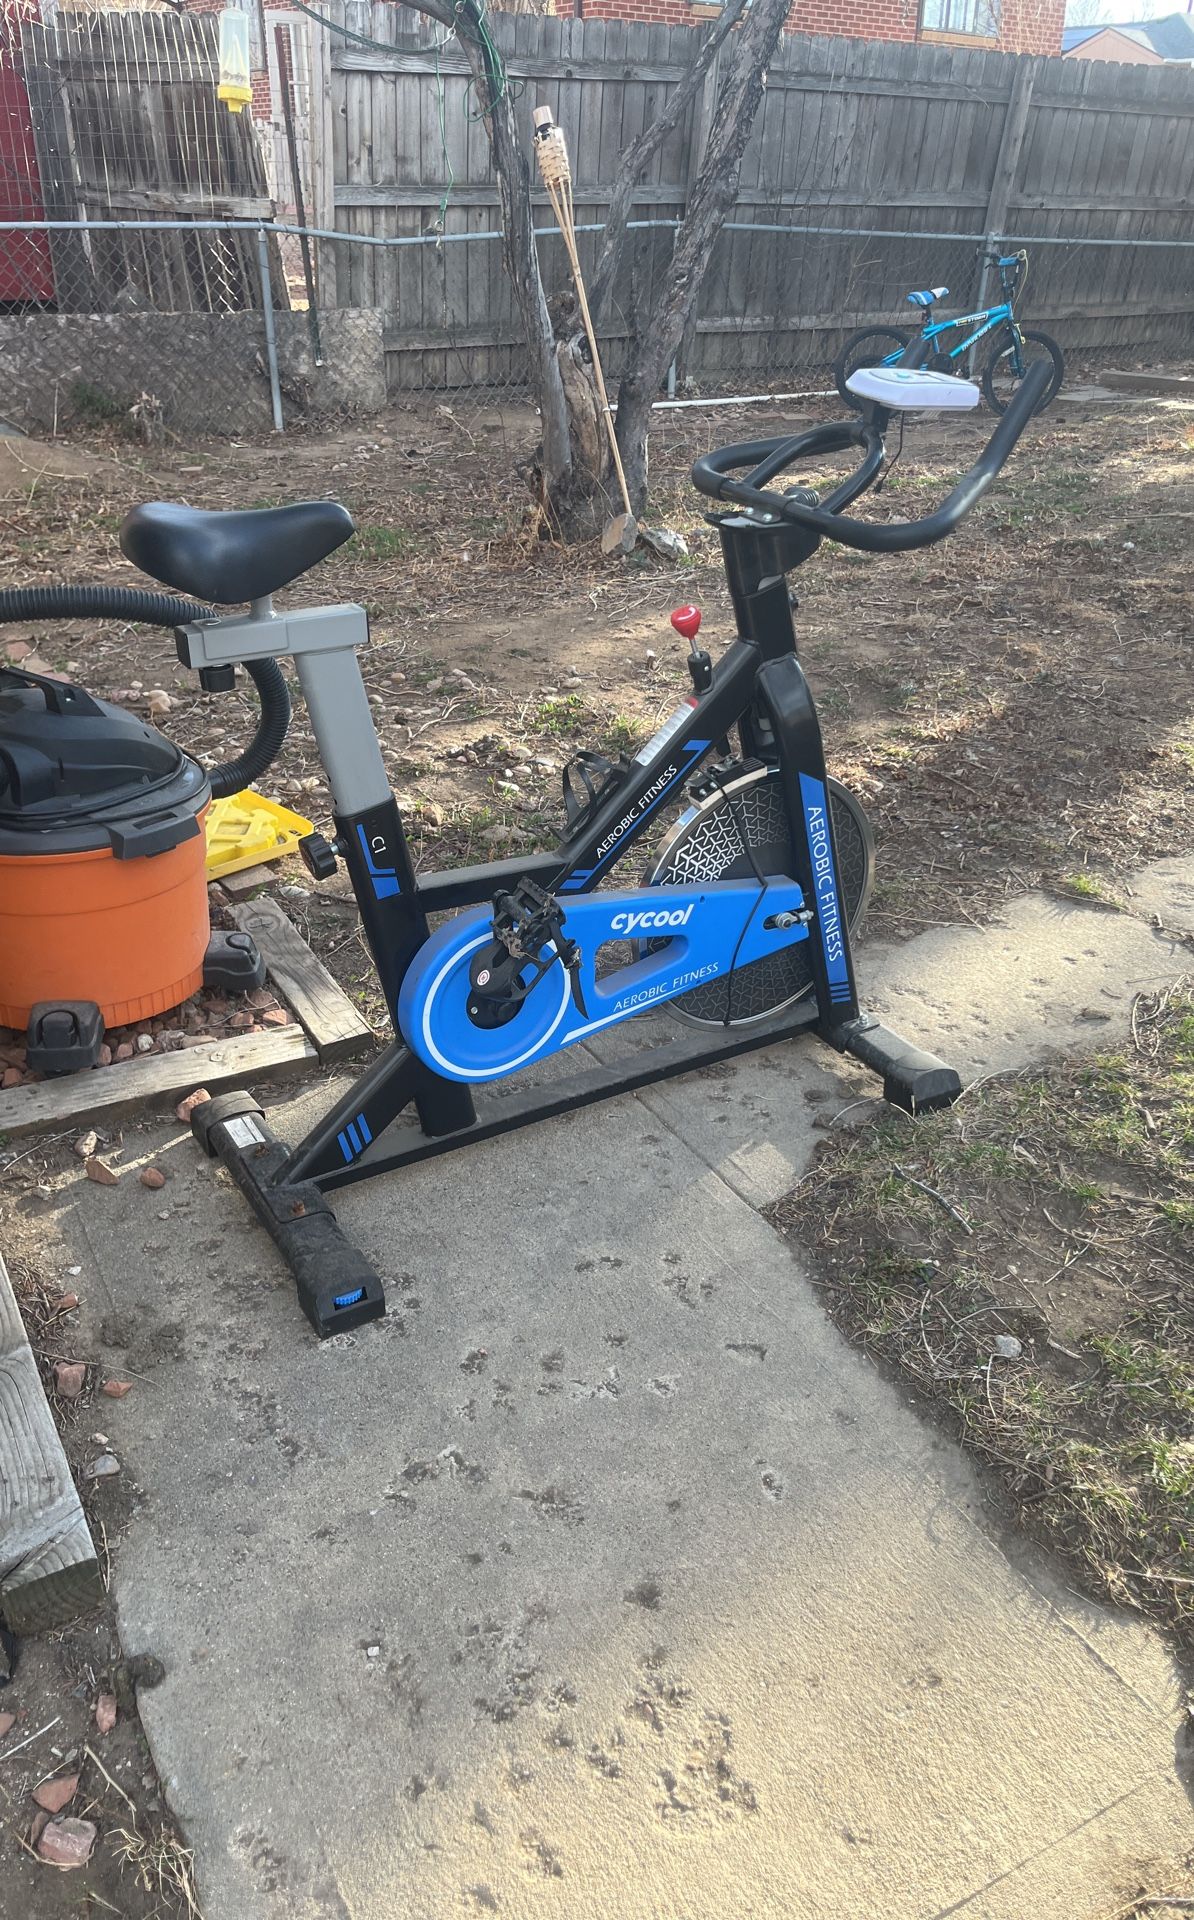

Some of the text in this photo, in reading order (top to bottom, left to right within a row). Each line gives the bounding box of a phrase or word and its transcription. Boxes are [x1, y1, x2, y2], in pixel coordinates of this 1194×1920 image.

[596, 807, 640, 859] AEROBIC
[638, 764, 678, 809] FITNESS
[371, 836, 386, 854] C1
[807, 806, 843, 962] AEROBIC FITNESS
[610, 903, 695, 935] cycool
[613, 962, 719, 1012] AEROBIC FITNESS
